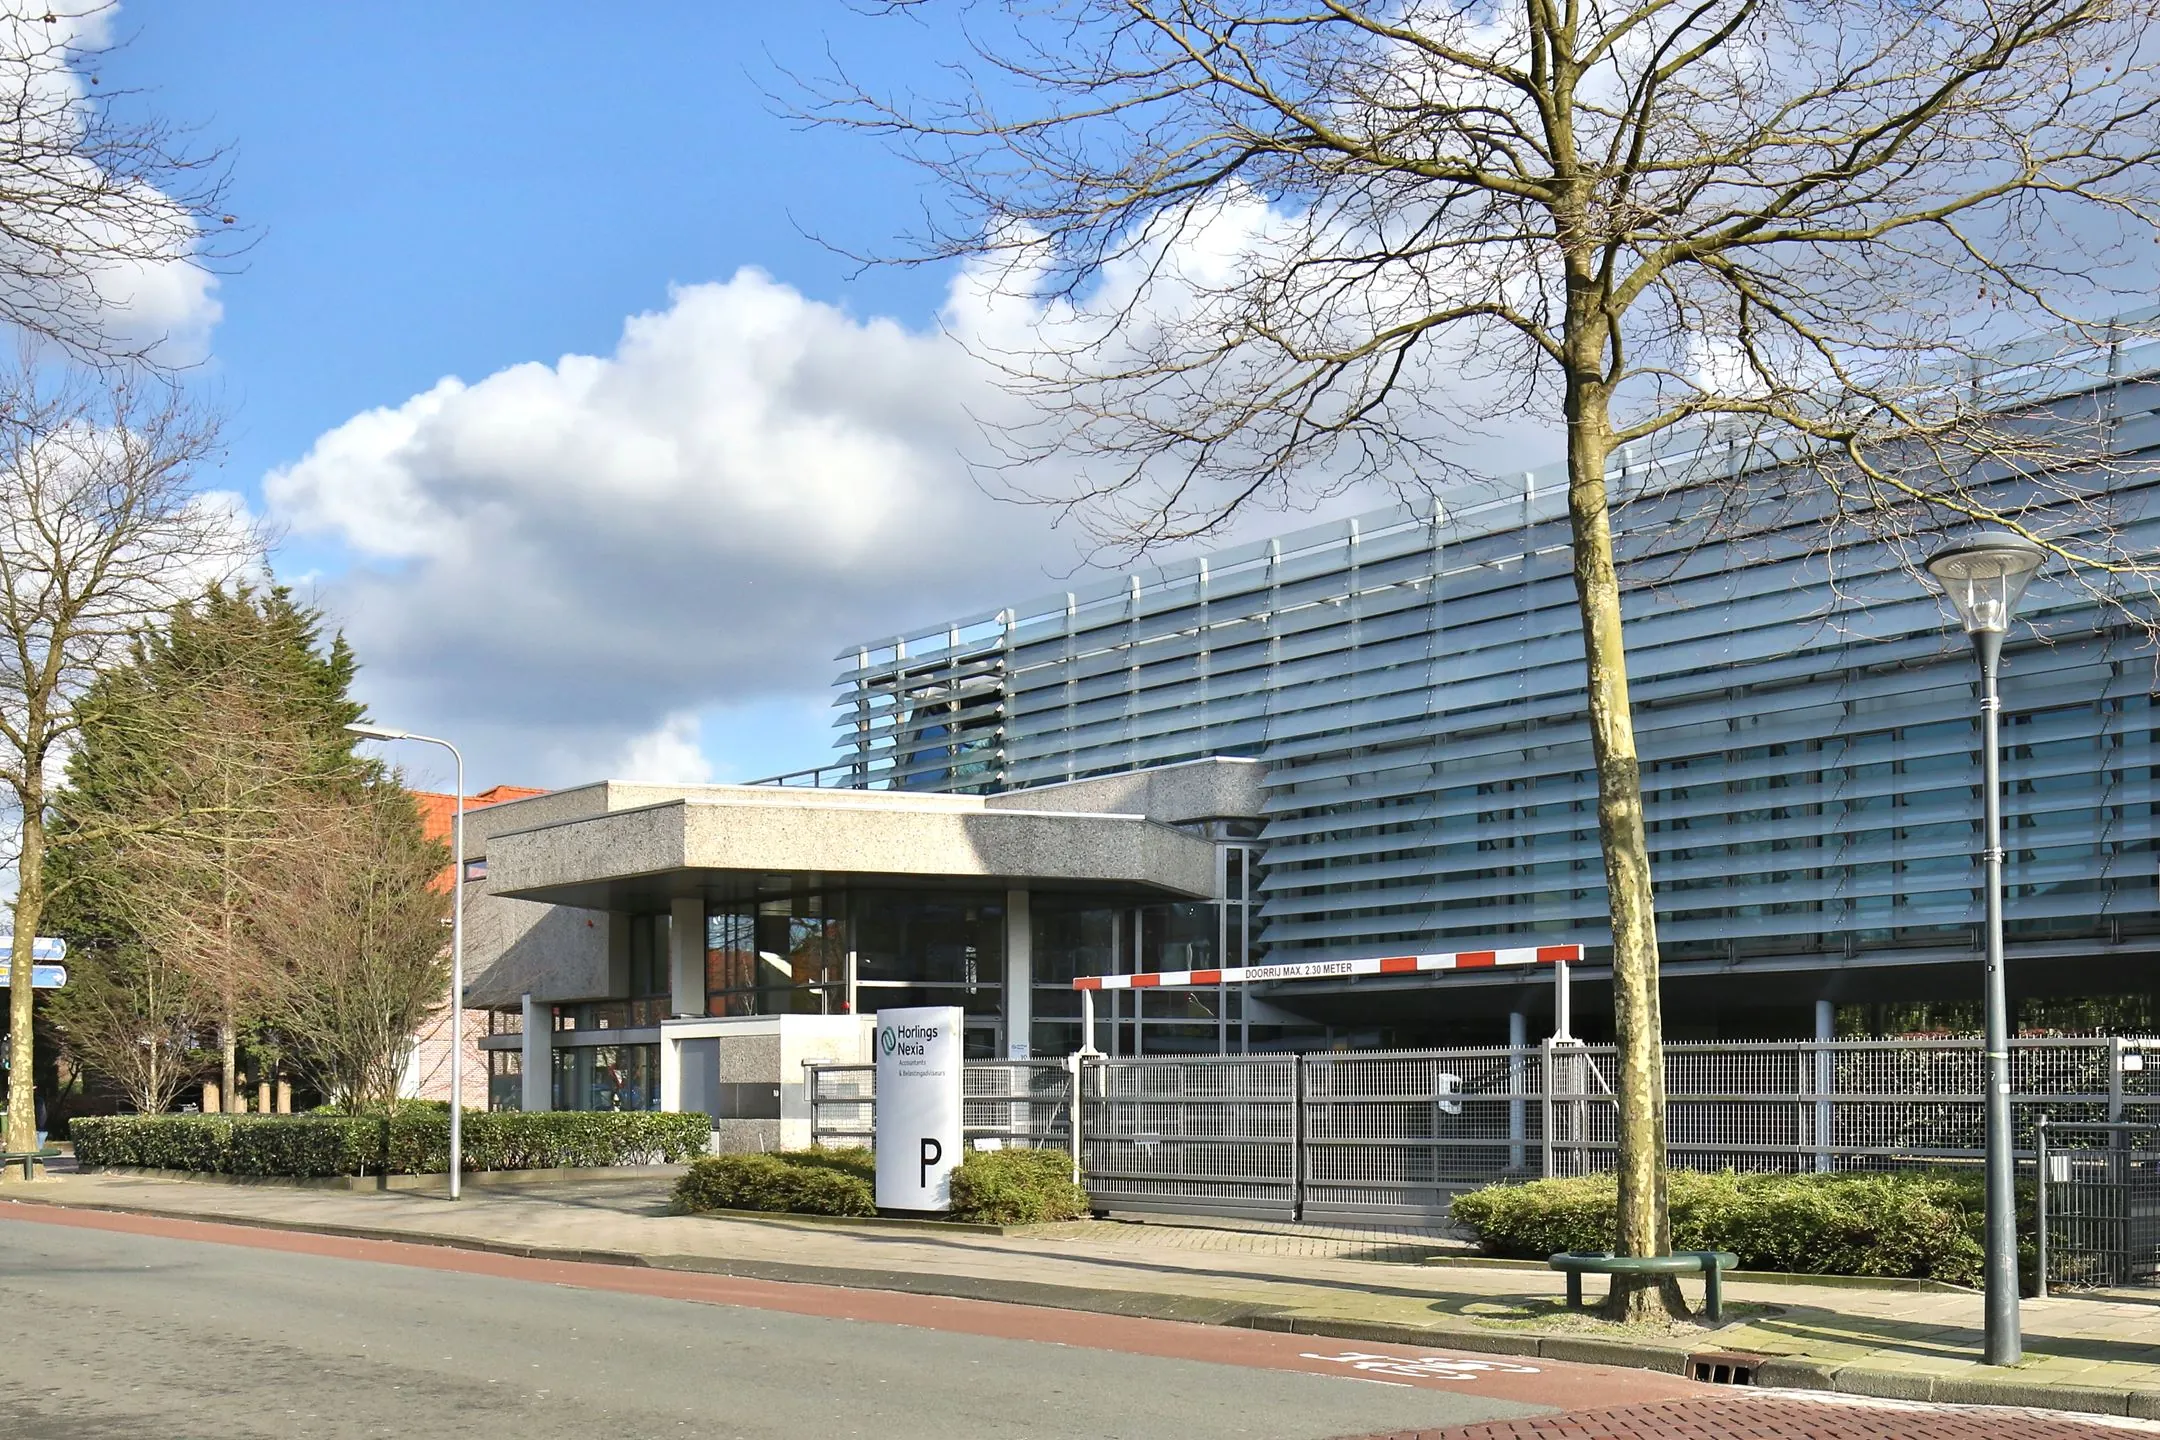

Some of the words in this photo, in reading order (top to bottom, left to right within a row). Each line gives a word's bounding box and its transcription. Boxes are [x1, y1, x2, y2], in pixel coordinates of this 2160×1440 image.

[1245, 967, 1281, 979] DOORRIJ
[1283, 966, 1303, 977] MAX.
[1305, 964, 1321, 975] 2.30
[1323, 962, 1353, 974] METER
[897, 1025, 938, 1042] Horlings
[897, 1042, 925, 1056] Nexia
[920, 1137, 942, 1188] P
